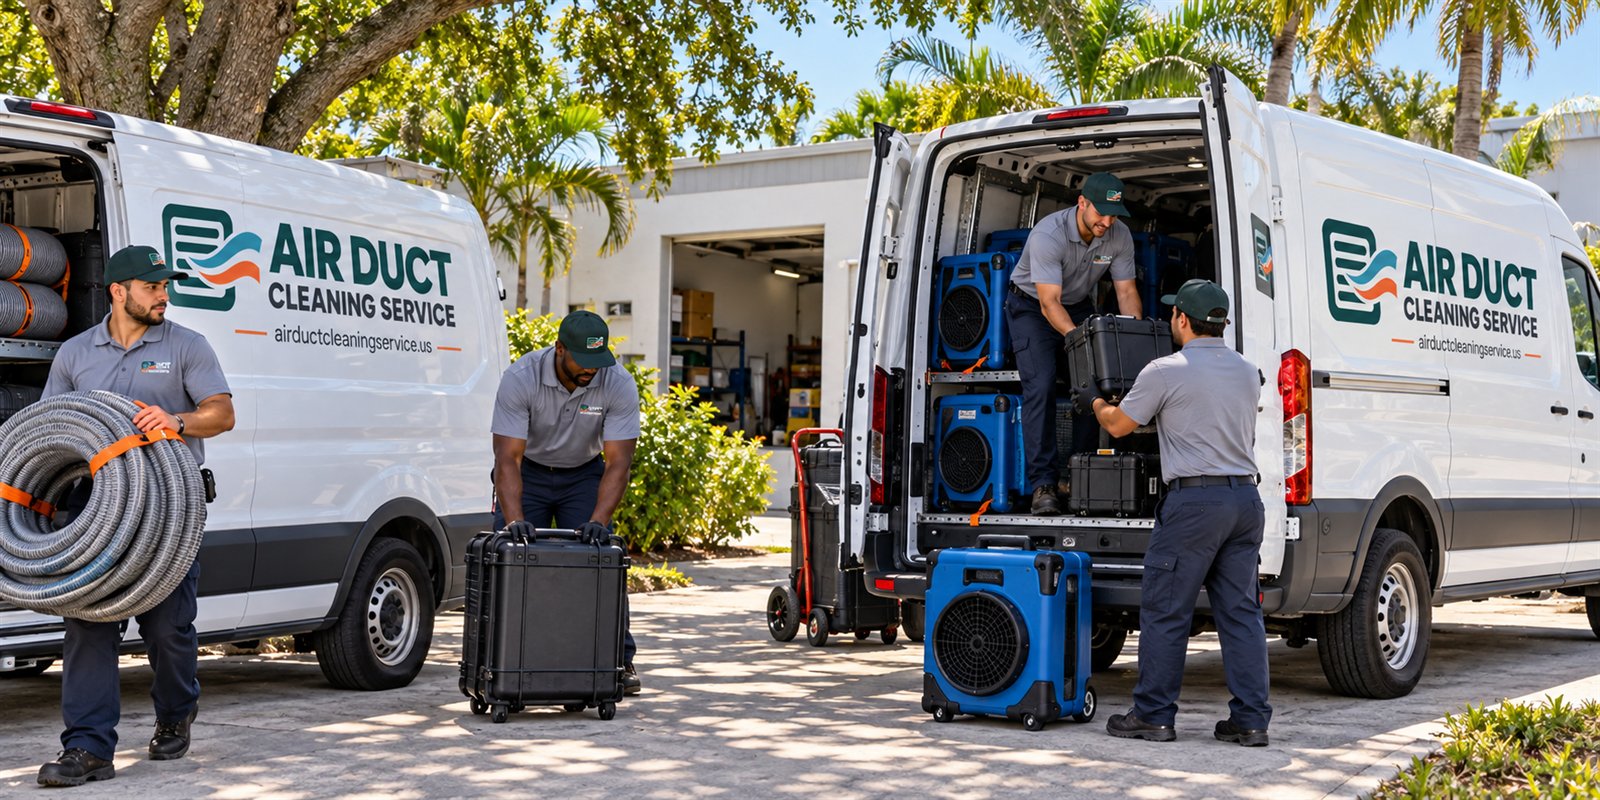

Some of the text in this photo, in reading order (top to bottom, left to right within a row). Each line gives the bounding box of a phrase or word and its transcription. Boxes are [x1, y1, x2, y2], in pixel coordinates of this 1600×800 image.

[269, 222, 452, 297] AIR DUCT
[1403, 240, 1537, 310] AIR DUCT
[268, 282, 456, 328] CLEANING SERVICE
[1403, 296, 1538, 338] CLEANING SERVICE
[274, 324, 433, 353] airductcleaningservice.us
[1418, 334, 1521, 359] airductcleaningservice.us
